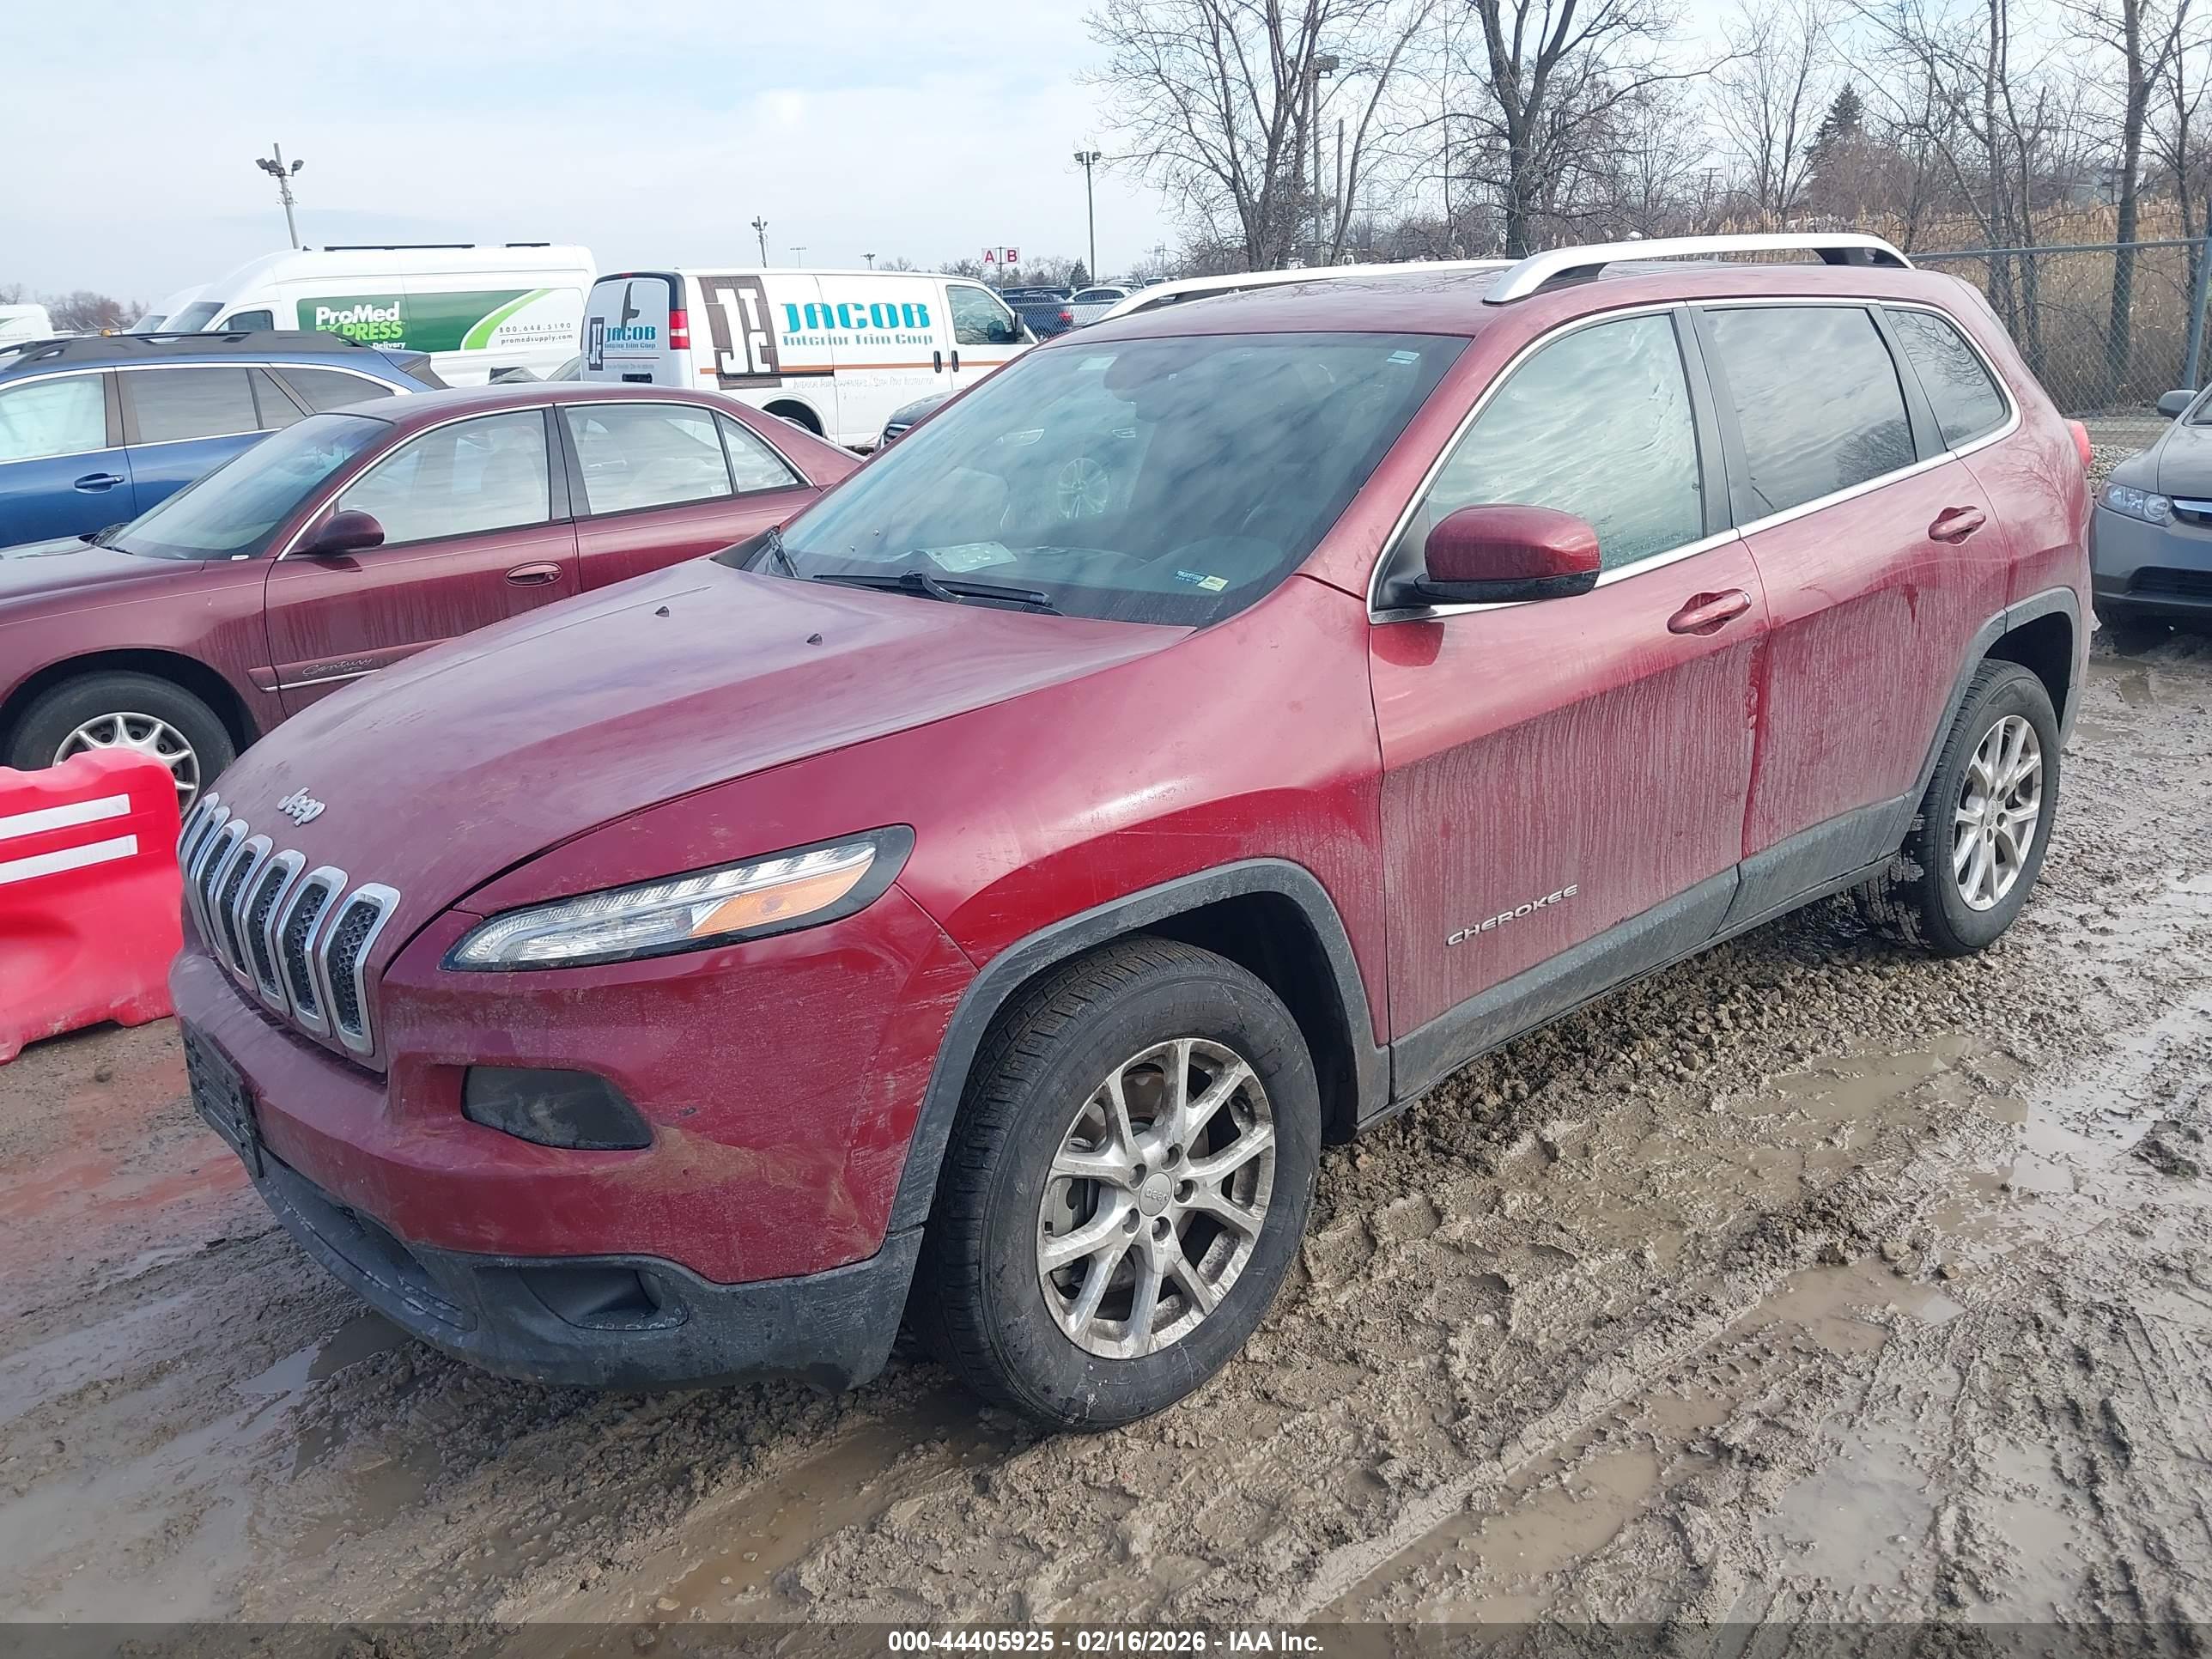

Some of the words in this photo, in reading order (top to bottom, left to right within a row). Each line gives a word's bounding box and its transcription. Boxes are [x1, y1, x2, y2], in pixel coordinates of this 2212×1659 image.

[984, 250, 994, 263] A
[1007, 249, 1018, 263] B
[315, 301, 400, 326] ProMed
[780, 302, 931, 333] JACOB
[501, 334, 574, 345] promedsupply.com
[605, 326, 656, 343] JACOB
[782, 334, 849, 346] Interior
[854, 334, 890, 345] Trim
[896, 333, 933, 345] Corp
[372, 341, 407, 350] Delivery
[302, 658, 373, 677] Century
[276, 787, 325, 827] Jeep
[1447, 884, 1578, 945] CHEROKEE
[1145, 1185, 1170, 1206] Jeep
